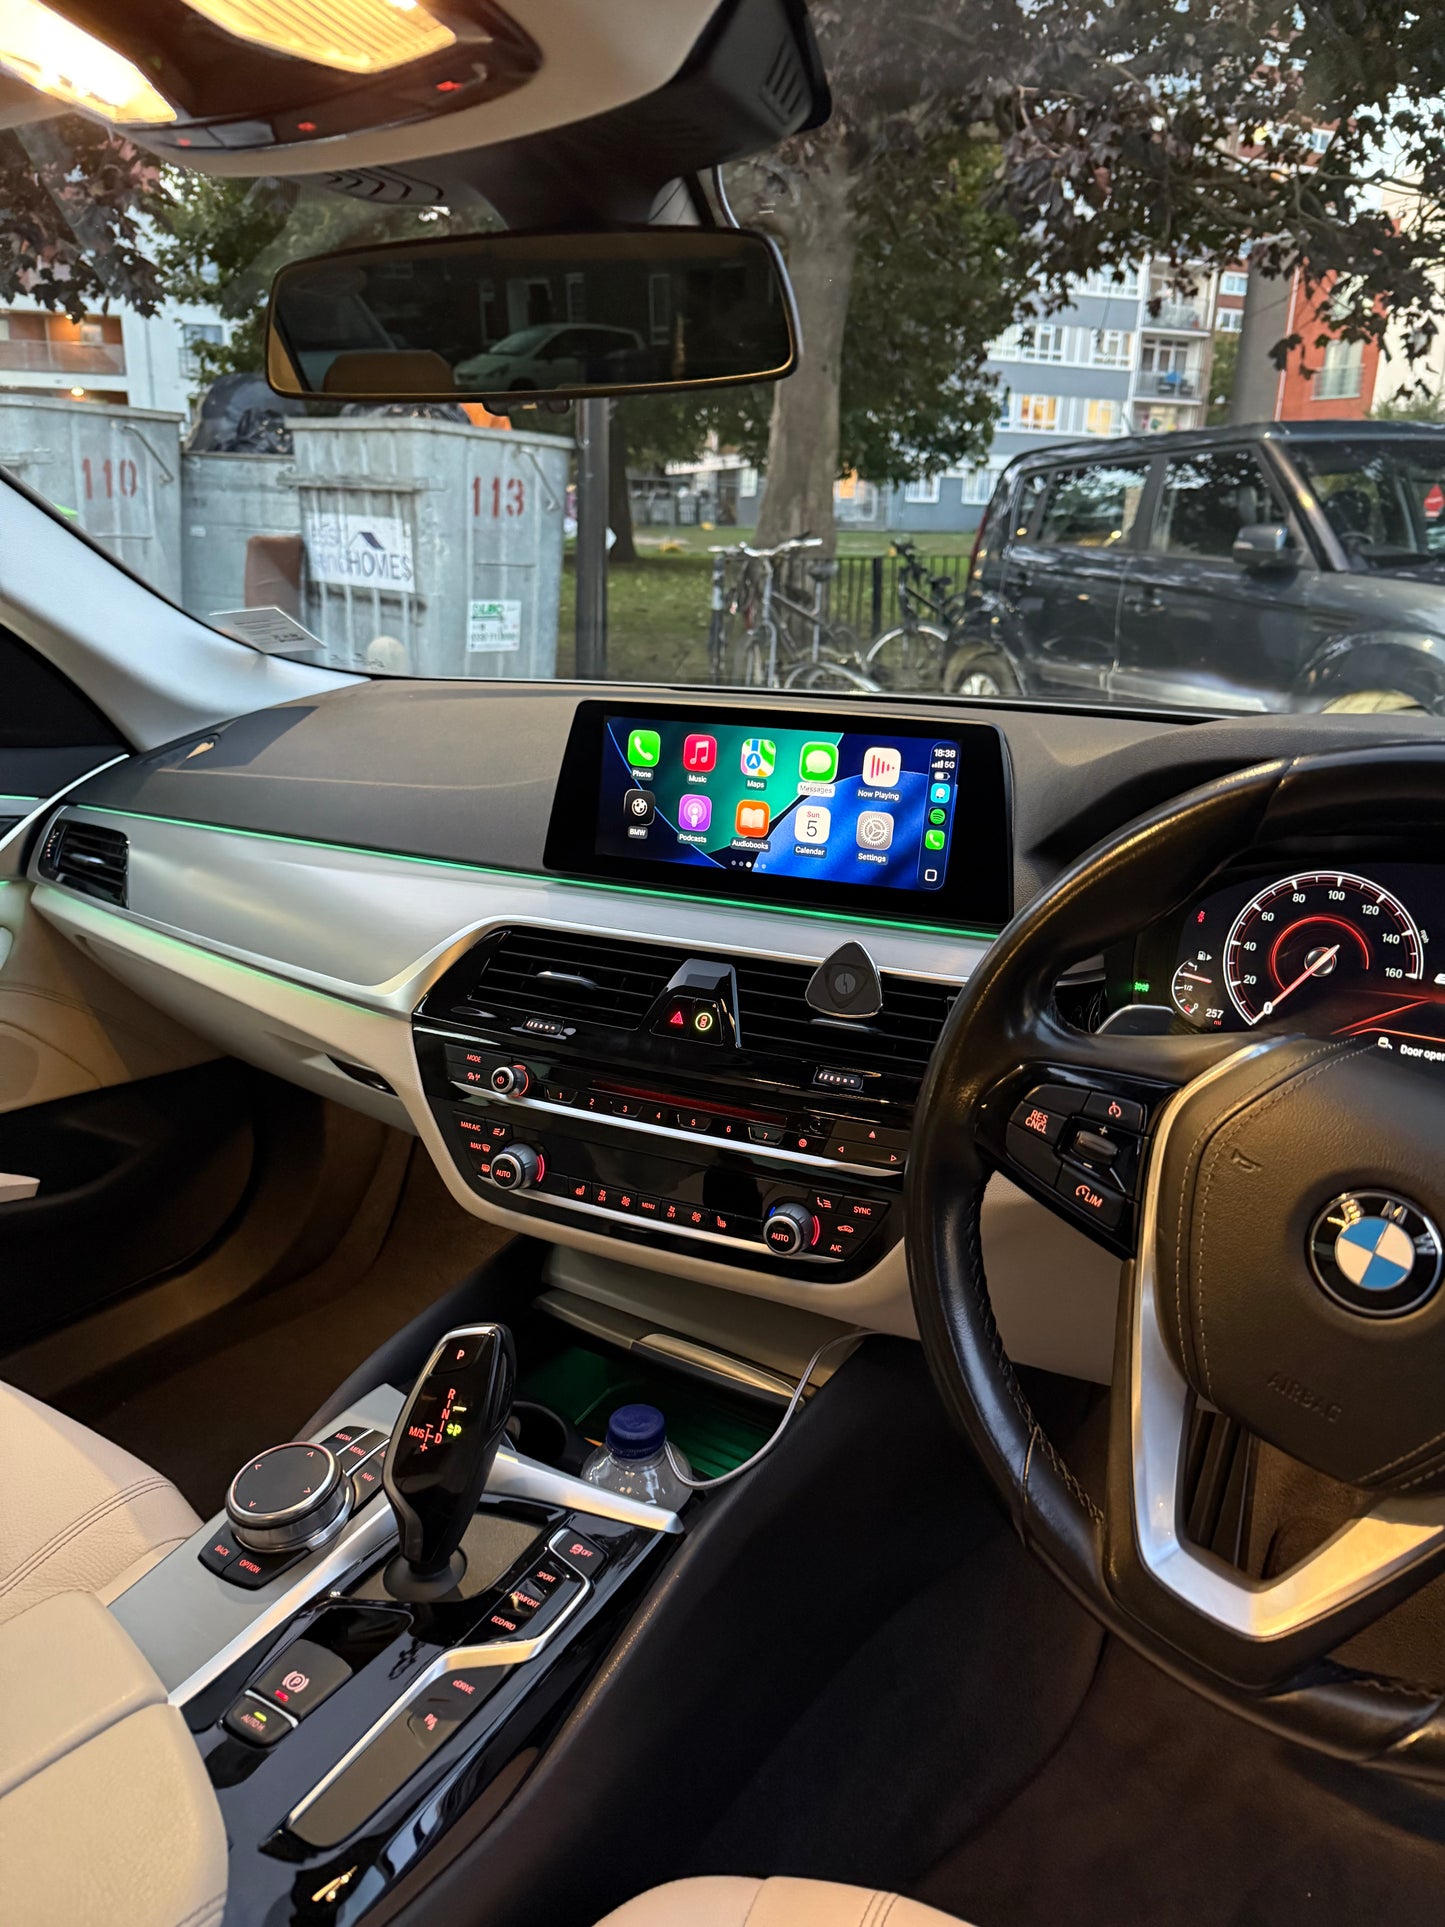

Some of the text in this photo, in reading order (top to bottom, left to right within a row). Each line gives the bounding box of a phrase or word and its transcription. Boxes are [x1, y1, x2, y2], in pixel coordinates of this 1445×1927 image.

[82, 457, 137, 500] 110
[472, 476, 524, 519] 113
[934, 748, 956, 758] 18:38
[944, 761, 955, 769] 5G
[632, 769, 652, 778] Phone
[688, 774, 707, 783] Music
[747, 780, 765, 789] Maps
[800, 785, 832, 795] Messages
[858, 789, 900, 801] Now Playing
[807, 811, 820, 819] Sun
[629, 828, 646, 837] BMW
[806, 820, 818, 837] 5
[679, 833, 707, 843] Podcasts
[732, 839, 769, 850] Audiobooks
[795, 846, 825, 856] Calendar
[858, 852, 886, 863] Settings
[1292, 893, 1306, 904] 80
[1327, 889, 1346, 901] 100
[1361, 904, 1380, 916] 120
[1261, 911, 1275, 922] 60
[1382, 933, 1400, 944] 140
[1244, 941, 1257, 952] 40
[1384, 967, 1403, 979] 160
[1243, 974, 1257, 985] 20
[1205, 1008, 1224, 1019] 257
[1400, 1043, 1423, 1058] Door
[466, 1054, 481, 1063] MODE
[1030, 1109, 1048, 1124] RES
[460, 1120, 472, 1129] MAX
[1025, 1117, 1047, 1134] CNCL
[470, 1142, 481, 1150] MAX
[496, 1169, 511, 1178] AUTO
[641, 1201, 655, 1210] MENU
[1084, 1193, 1103, 1208] LIM
[853, 1206, 872, 1216] SYNC
[1341, 1199, 1436, 1255] BMW
[771, 1232, 789, 1242] AUTO
[830, 1243, 842, 1253] A/C
[456, 1349, 465, 1360] P
[448, 1388, 456, 1400] R
[441, 1408, 450, 1420] N
[409, 1426, 425, 1439] M/S
[434, 1432, 443, 1444] D
[350, 1445, 366, 1457] MENU
[362, 1472, 376, 1482] NAV
[214, 1544, 230, 1557] BACK
[581, 1548, 594, 1558] OFF
[239, 1559, 261, 1574] OPTION
[537, 1570, 556, 1583] SPORT
[513, 1591, 540, 1609] COMFORT
[491, 1615, 504, 1626] ECO
